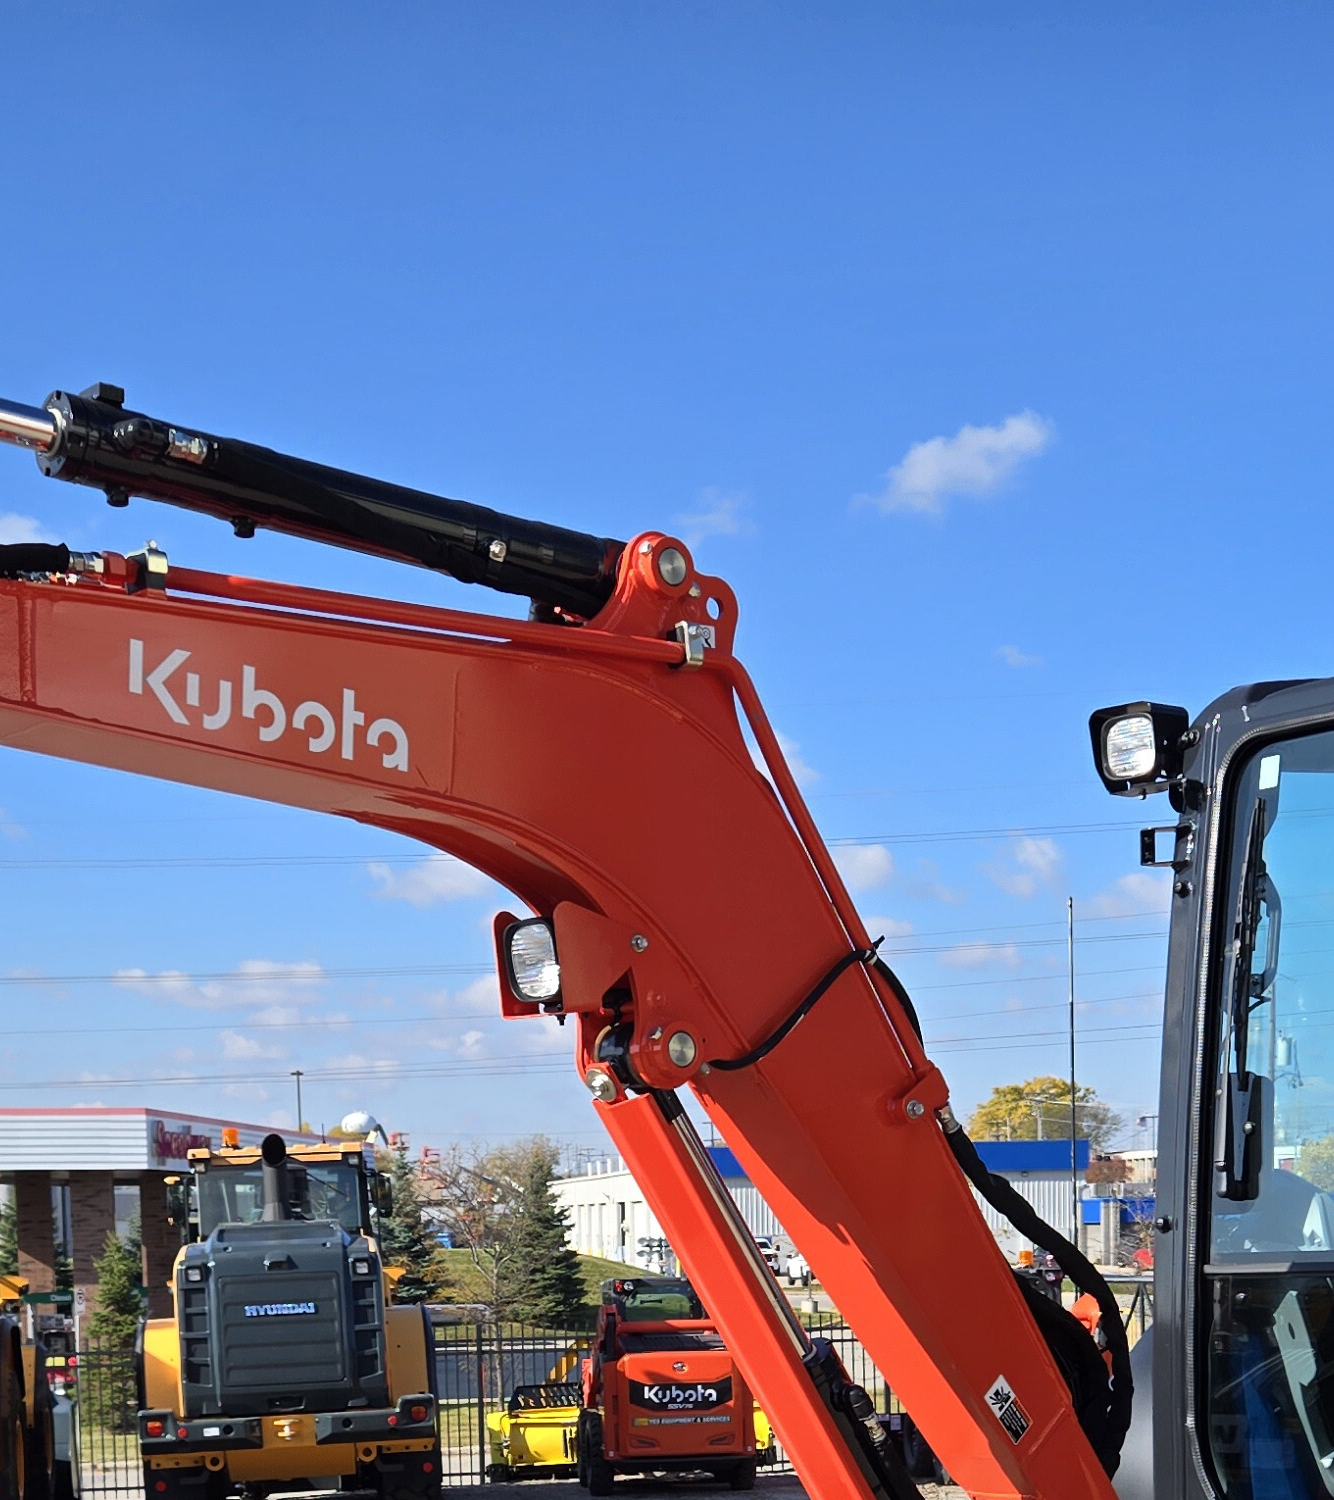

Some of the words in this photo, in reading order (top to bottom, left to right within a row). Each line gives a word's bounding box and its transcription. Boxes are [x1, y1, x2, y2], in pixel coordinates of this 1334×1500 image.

[128, 637, 409, 773] Kubota
[244, 1302, 316, 1317] HYUNDAI
[644, 1384, 717, 1403] Kubota
[649, 1417, 660, 1425] YES
[661, 1417, 695, 1425] EQUIPMENT
[702, 1415, 731, 1423] SERVICES
